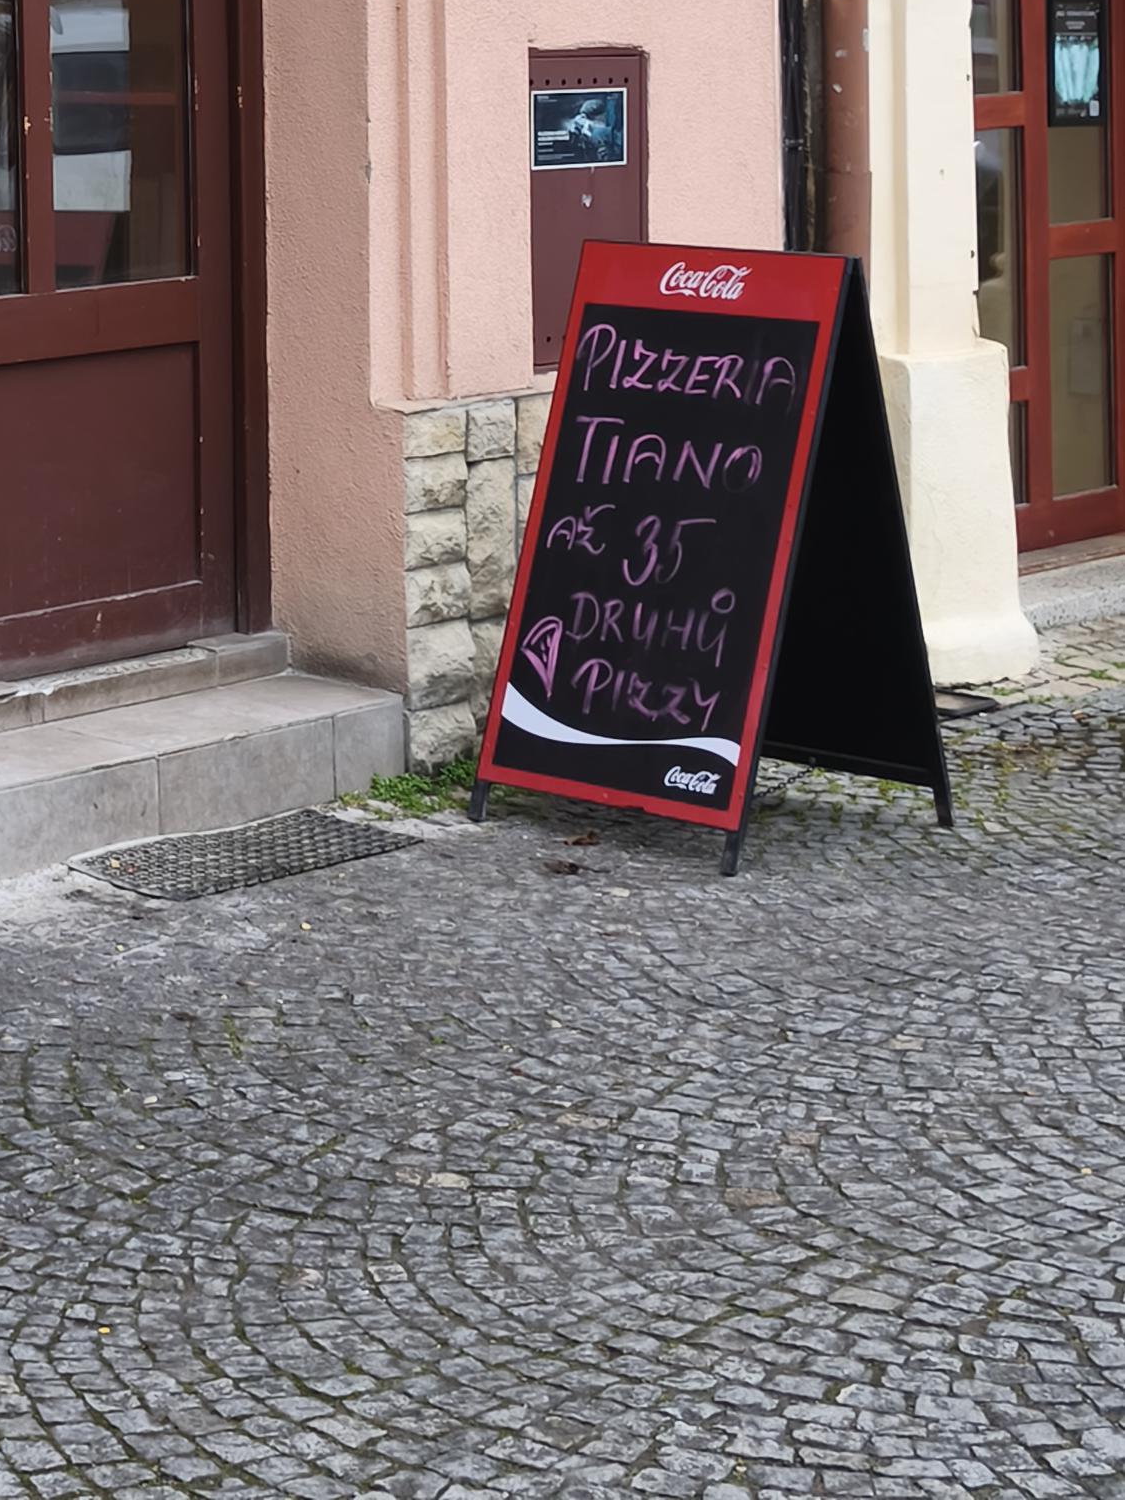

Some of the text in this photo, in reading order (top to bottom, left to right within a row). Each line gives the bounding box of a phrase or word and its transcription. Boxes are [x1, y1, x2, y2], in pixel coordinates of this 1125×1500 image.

[659, 261, 753, 300] Coca-Cola
[576, 323, 797, 408] PIZZERIA
[576, 415, 763, 492] TIANO
[546, 504, 717, 586] AŽ 35
[565, 588, 736, 668] DRUHŮ
[571, 658, 721, 733] PIZZY
